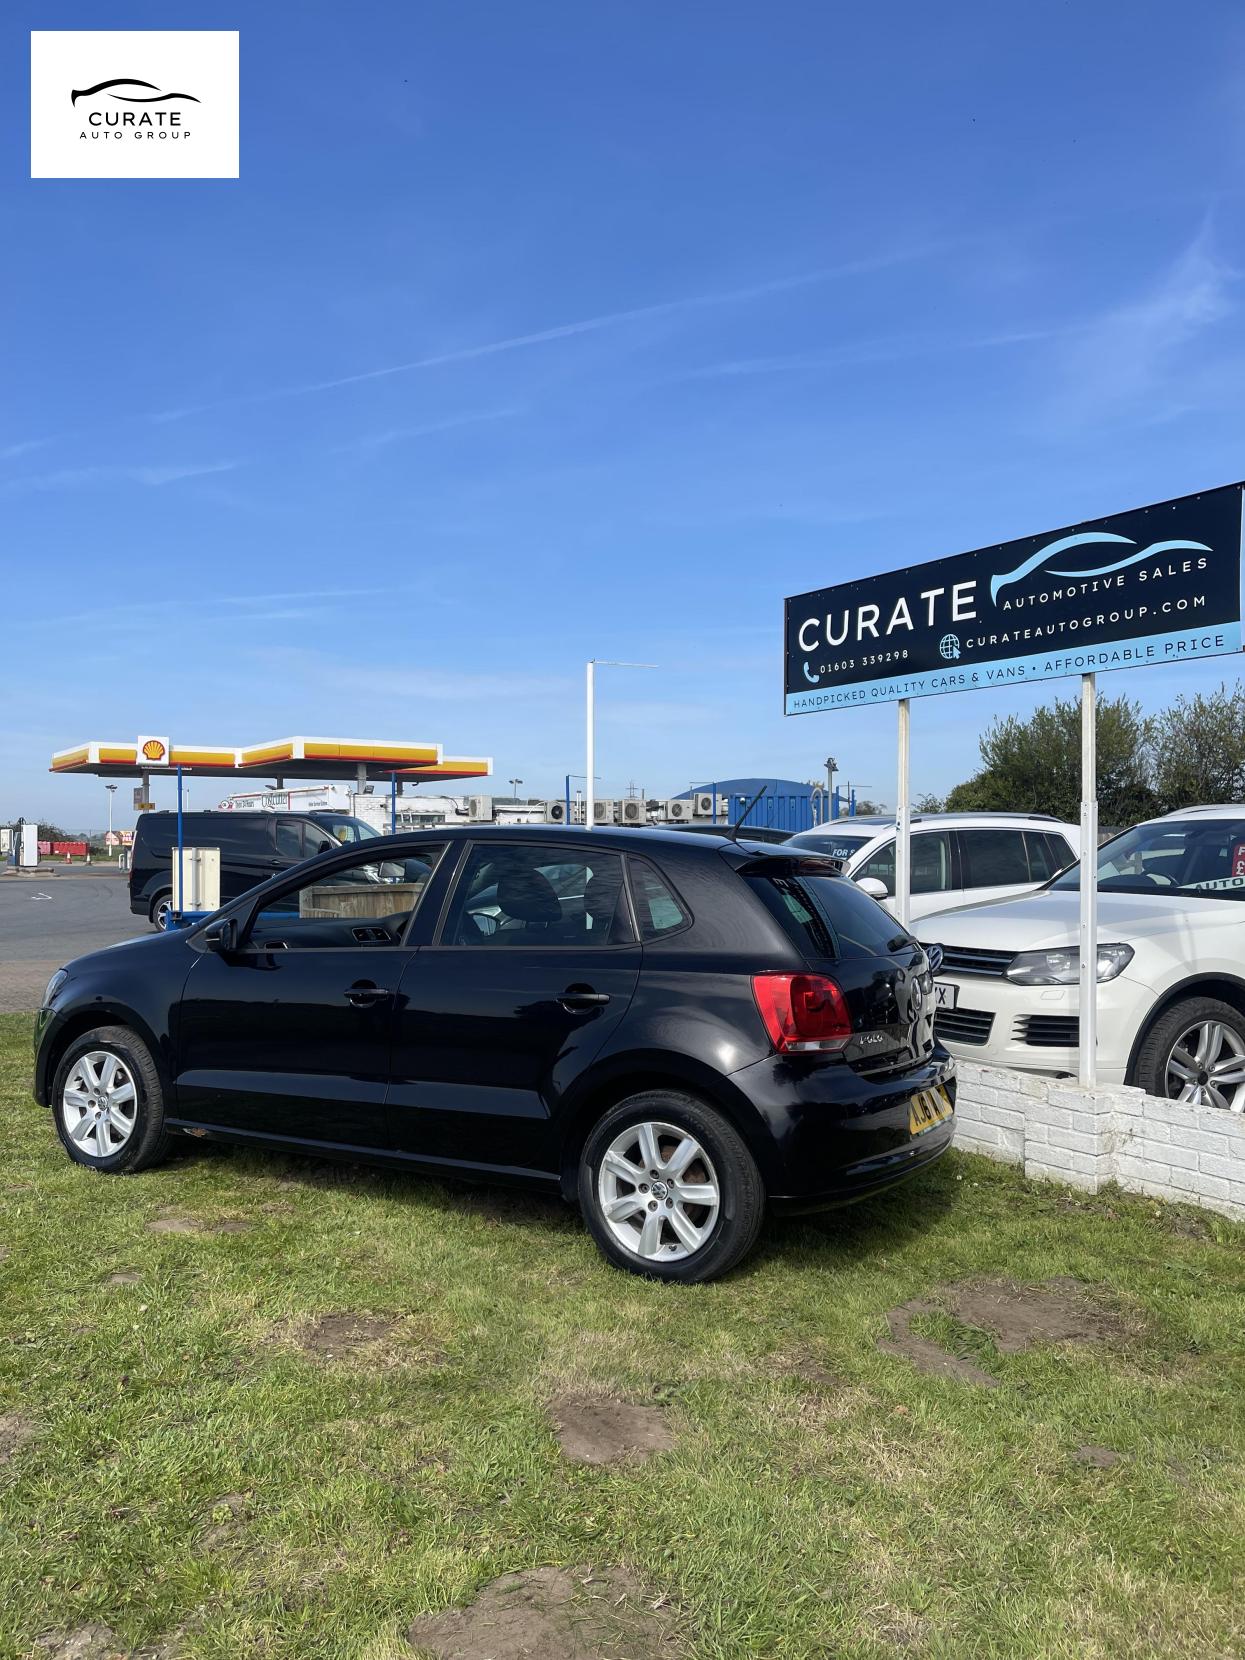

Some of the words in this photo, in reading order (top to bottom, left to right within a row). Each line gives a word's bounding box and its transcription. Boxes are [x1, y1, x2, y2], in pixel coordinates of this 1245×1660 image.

[1003, 575, 1125, 611] AUTOMOTIVE
[1139, 558, 1207, 582] SALES
[798, 580, 977, 652] CURATE
[966, 596, 1205, 648] CURATEAUTOGROUP.COM
[793, 690, 866, 709] HANDPICKED
[871, 680, 925, 698] QUALITY
[931, 674, 966, 688] CARS
[972, 672, 979, 682] &
[986, 665, 1025, 680] VANS
[1044, 646, 1155, 672] AFFORDABLE
[1165, 635, 1225, 654] PRICE
[820, 659, 855, 674] 01603
[862, 650, 909, 666] 339298
[832, 849, 848, 858] FOR
